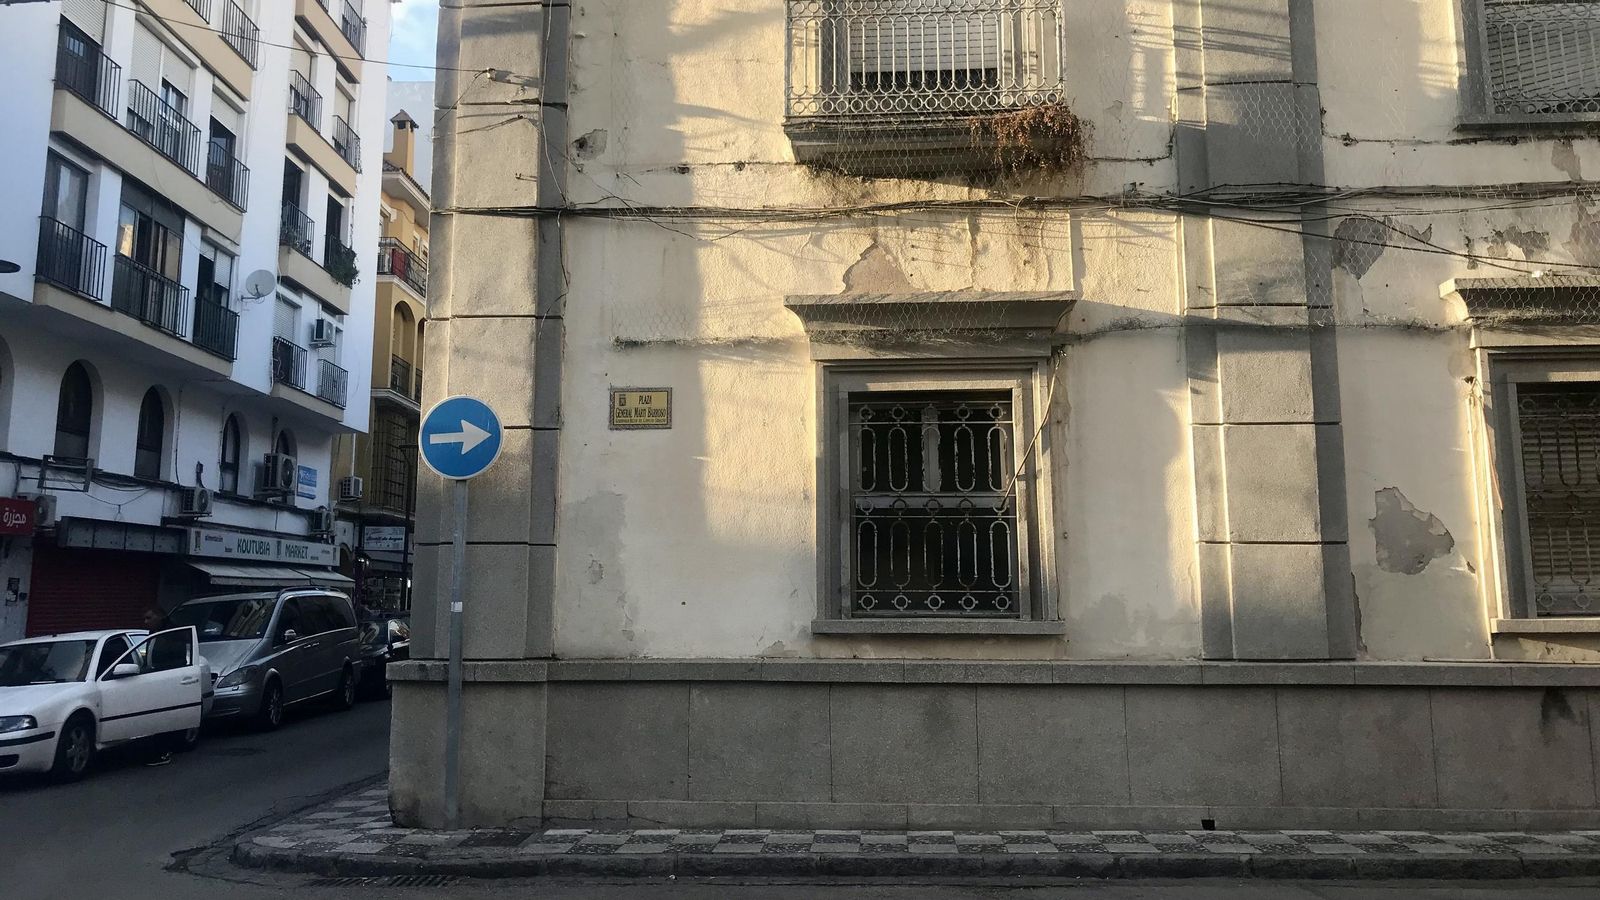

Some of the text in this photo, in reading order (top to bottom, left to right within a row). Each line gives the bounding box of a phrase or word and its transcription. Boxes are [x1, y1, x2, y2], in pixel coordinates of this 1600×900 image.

[638, 395, 652, 405] PLAZA
[3, 507, 27, 528] مجزرة
[236, 537, 309, 560] KOUTUBIA MARKET
